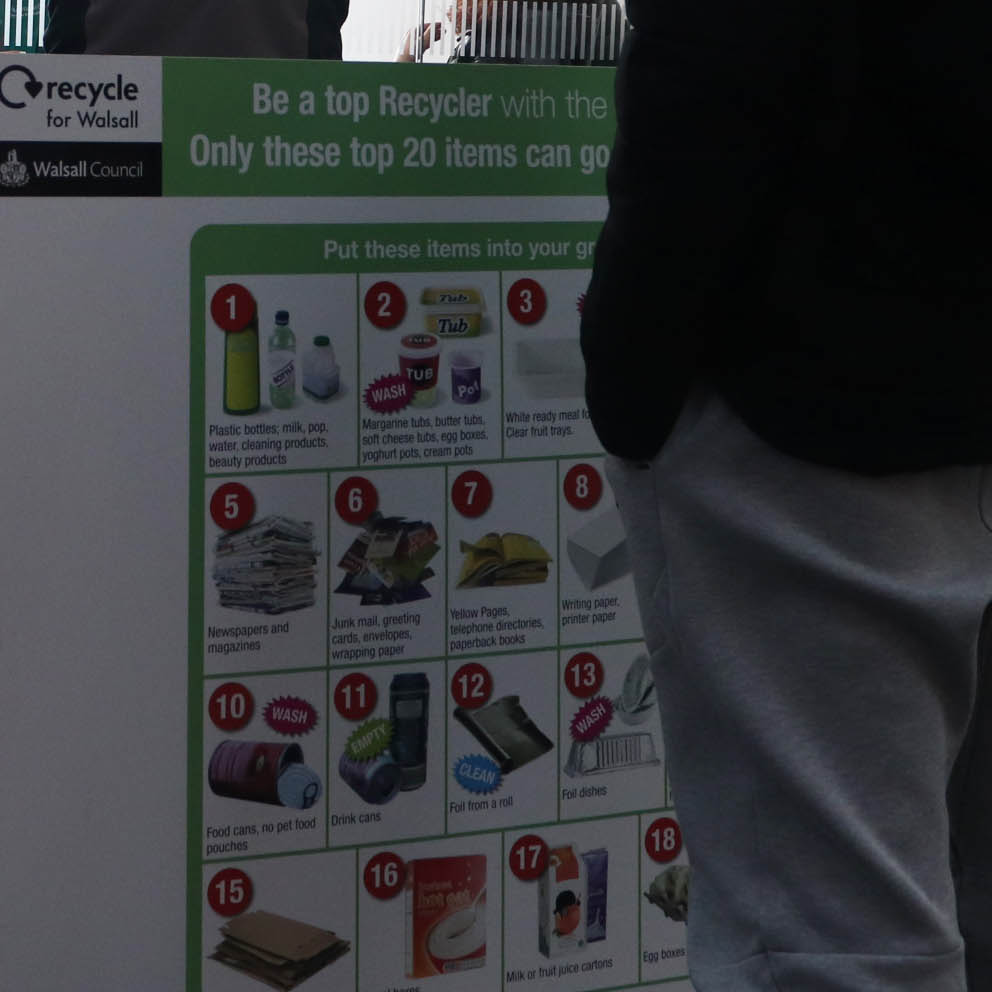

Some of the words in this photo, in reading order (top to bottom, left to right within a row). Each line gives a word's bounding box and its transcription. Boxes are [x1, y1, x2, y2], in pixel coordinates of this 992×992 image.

[46, 74, 138, 108] recycle
[253, 83, 289, 115] Be
[300, 92, 316, 115] a
[325, 86, 369, 122] top
[380, 85, 490, 124] Recycler
[501, 88, 556, 118] with
[566, 89, 608, 118] the
[46, 109, 73, 128] for
[77, 109, 138, 128] Walsall
[190, 134, 252, 173] Only
[263, 135, 341, 167] these
[351, 137, 394, 175] top
[403, 137, 436, 167] 20
[445, 136, 517, 168] items
[525, 142, 571, 168] can
[581, 143, 610, 175] go
[34, 158, 87, 177] Walsall
[90, 160, 143, 178] Council
[324, 239, 358, 259] Put
[365, 238, 420, 259] these
[426, 238, 483, 258] items
[487, 238, 523, 257] into
[528, 241, 570, 261] your
[225, 295, 237, 319] 1
[376, 292, 392, 317] 2
[519, 290, 532, 312] 3
[438, 318, 468, 333] Tub
[406, 367, 433, 381] TUB
[371, 383, 407, 403] WASH
[362, 416, 408, 431] Margarine
[435, 415, 461, 427] butter
[506, 411, 529, 423] White
[533, 409, 557, 423] ready
[559, 409, 579, 420] meal
[209, 424, 240, 436] Plastic
[362, 434, 379, 446] soft
[382, 432, 414, 445] cheese
[441, 431, 457, 444] egg
[506, 426, 528, 438] Clear
[531, 425, 548, 437] fruit
[242, 438, 282, 451] cleaning
[362, 448, 397, 463] yoghurt
[424, 446, 451, 457] cream
[454, 444, 473, 457] pots
[209, 455, 242, 468] beauty
[245, 454, 287, 467] products
[464, 480, 479, 505] 7
[576, 474, 589, 498] 8
[224, 494, 239, 519] 5
[348, 488, 363, 513] 6
[450, 608, 478, 620] Yellow
[561, 599, 592, 611] Writing
[332, 616, 355, 629] Junk
[382, 612, 420, 627] greeting
[561, 613, 589, 626] printer
[592, 611, 616, 624] paper
[208, 624, 268, 638] Newspapers
[271, 621, 289, 634] and
[450, 622, 493, 635] telephone
[208, 640, 261, 655] magazines
[332, 632, 360, 645] cards,
[450, 636, 496, 652] paperback
[499, 633, 525, 646] books
[332, 645, 376, 661] wrapping
[378, 644, 405, 657] paper
[570, 662, 597, 687] 13
[457, 674, 485, 699] 12
[217, 692, 246, 720] 10
[342, 684, 367, 710] 11
[271, 706, 308, 725] WASH
[574, 703, 608, 734] WASH
[349, 725, 389, 755] EMPTY
[457, 762, 498, 786] CLEAN
[562, 788, 576, 800] Foil
[579, 784, 608, 797] dishes
[449, 801, 465, 813] Foil
[468, 799, 489, 811] from
[491, 800, 497, 809] a
[499, 796, 513, 808] roll
[207, 825, 230, 838] Food
[233, 823, 259, 836] cans,
[262, 822, 274, 833] no
[277, 820, 292, 835] pet
[295, 816, 316, 830] food
[331, 813, 356, 826] Drink
[359, 812, 381, 824] cans
[207, 840, 248, 856] pouches
[651, 827, 676, 852] 18
[516, 844, 542, 870] 17
[370, 862, 399, 888] 16
[214, 878, 244, 904] 15
[643, 951, 659, 964] Egg
[506, 970, 524, 983] Milk
[527, 970, 536, 981] or
[539, 964, 556, 978] fruit
[558, 963, 579, 978] juice
[581, 958, 614, 972] cartons
